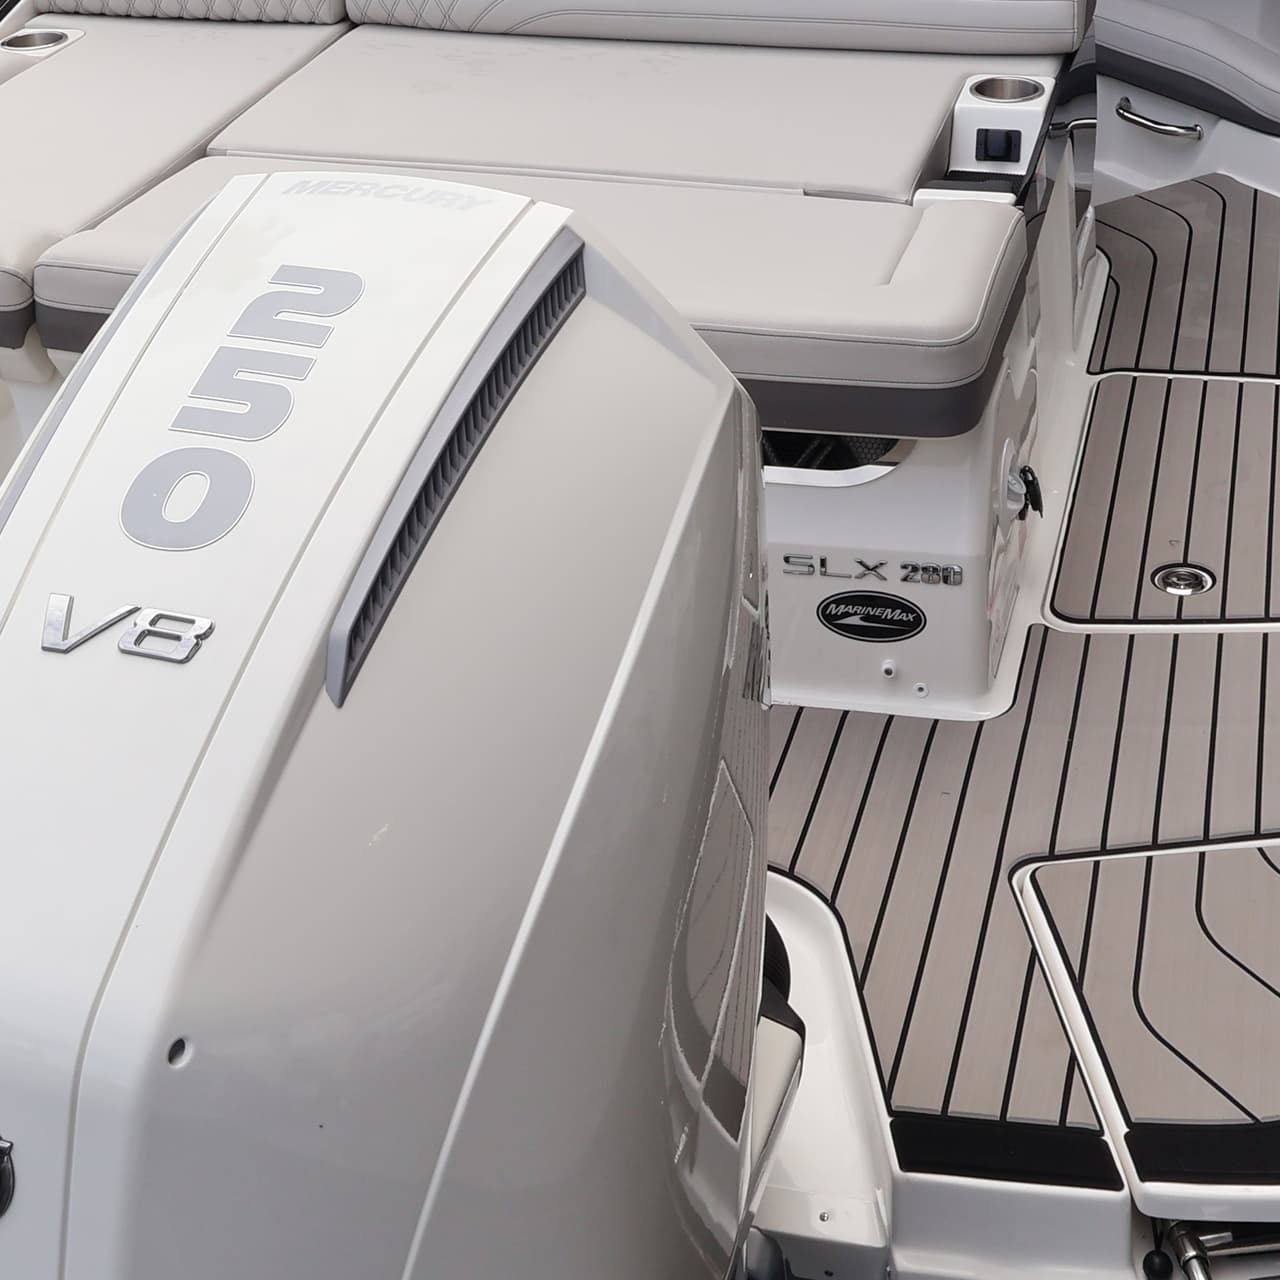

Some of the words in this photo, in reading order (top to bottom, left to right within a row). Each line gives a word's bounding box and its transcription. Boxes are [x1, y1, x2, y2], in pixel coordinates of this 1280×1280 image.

[281, 179, 502, 211] MERCURY
[119, 264, 366, 552] 250
[782, 553, 888, 582] SLX
[900, 561, 964, 586] 280
[40, 592, 216, 664] V8
